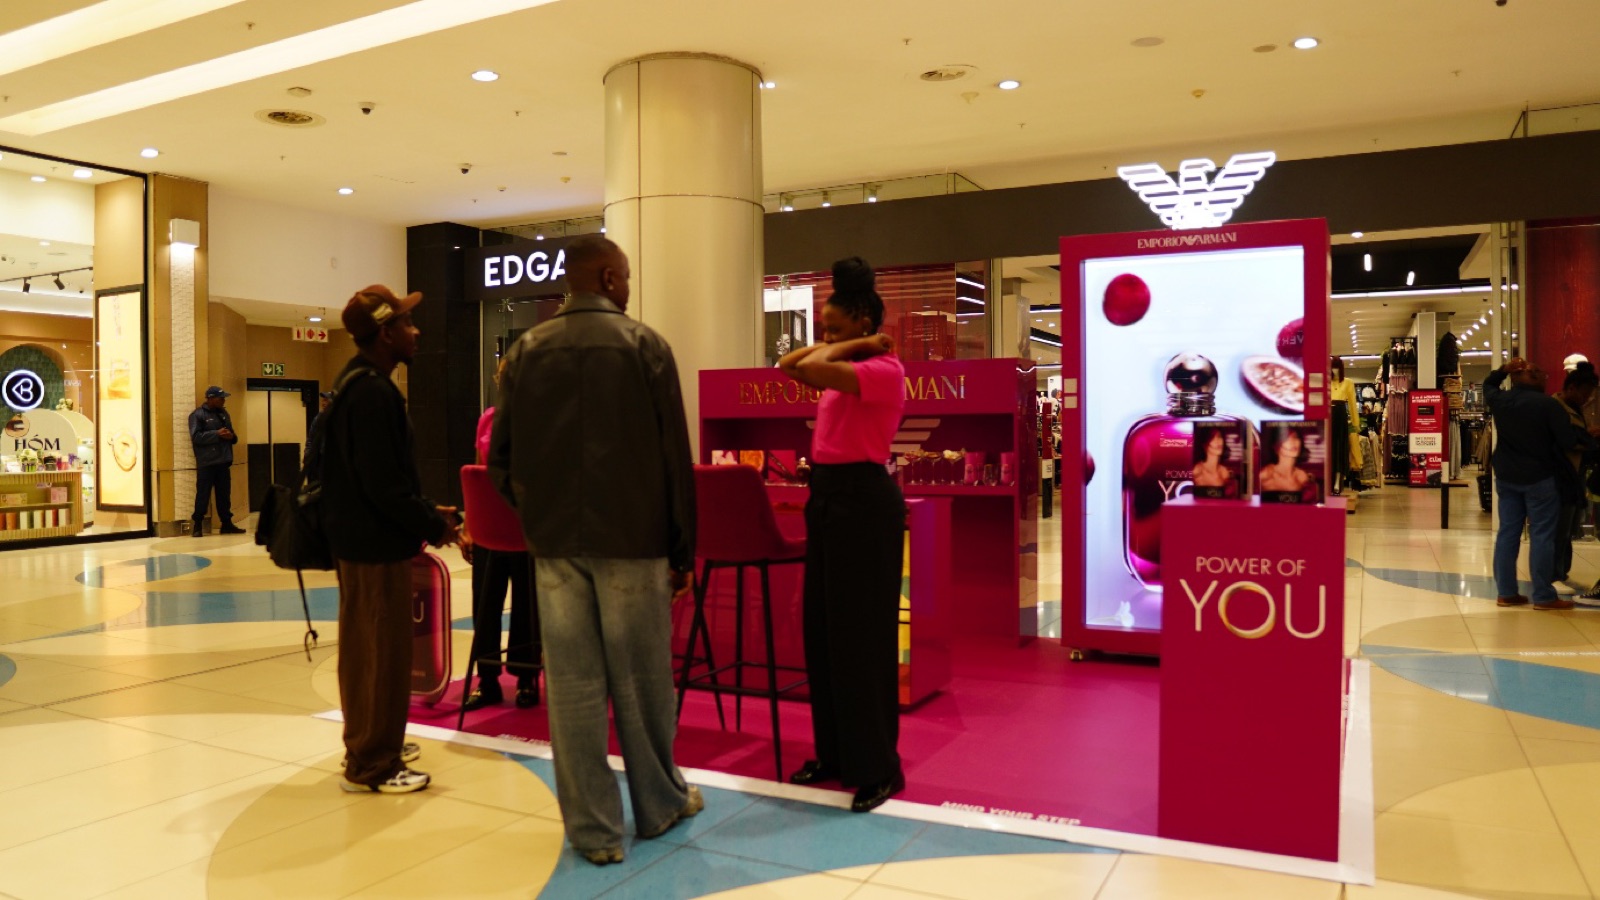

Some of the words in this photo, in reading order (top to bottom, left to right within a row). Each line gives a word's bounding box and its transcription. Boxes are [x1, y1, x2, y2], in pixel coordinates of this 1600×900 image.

[1137, 237, 1183, 249] EMPORIO
[1195, 231, 1237, 245] ARMANI
[484, 248, 567, 287] EDGA
[903, 374, 966, 401] MANI
[1165, 470, 1194, 479] POWE
[1195, 556, 1273, 576] POWER
[1276, 559, 1307, 577] OF
[1179, 578, 1327, 640] YOU
[941, 801, 985, 813] MIND
[989, 807, 1034, 820] YOUR
[1036, 814, 1081, 826] STEP
